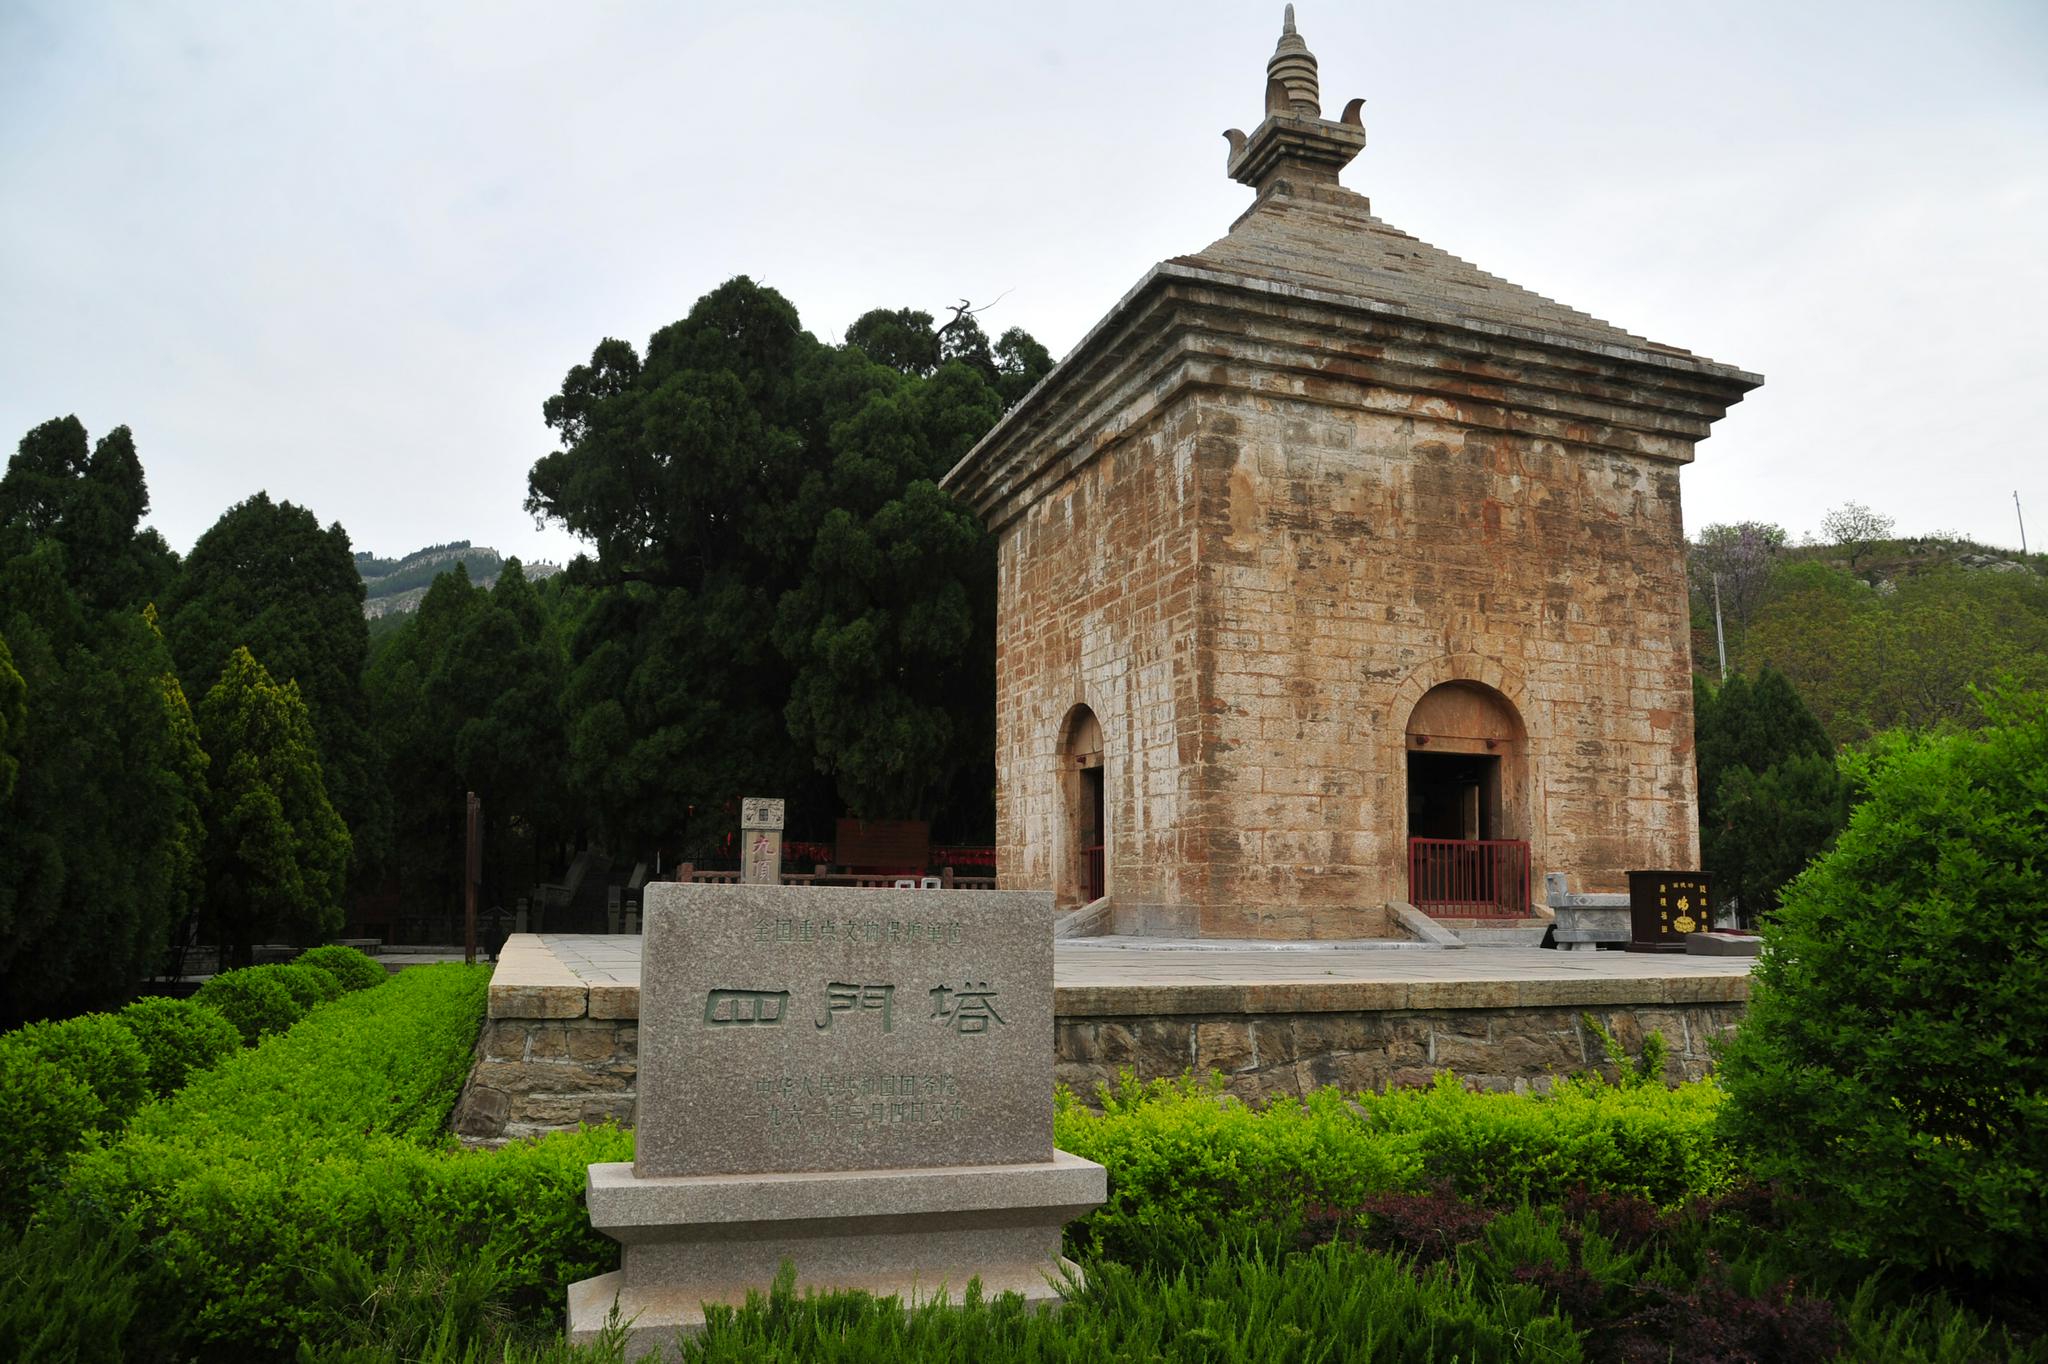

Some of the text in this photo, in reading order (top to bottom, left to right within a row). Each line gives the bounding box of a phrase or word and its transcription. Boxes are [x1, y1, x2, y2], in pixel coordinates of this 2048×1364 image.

[753, 918, 963, 944] 全国重点文物保护单位
[756, 1074, 957, 1098] 中华人民共和国国务院
[745, 1099, 966, 1126] 一九六一年三月四日公布
